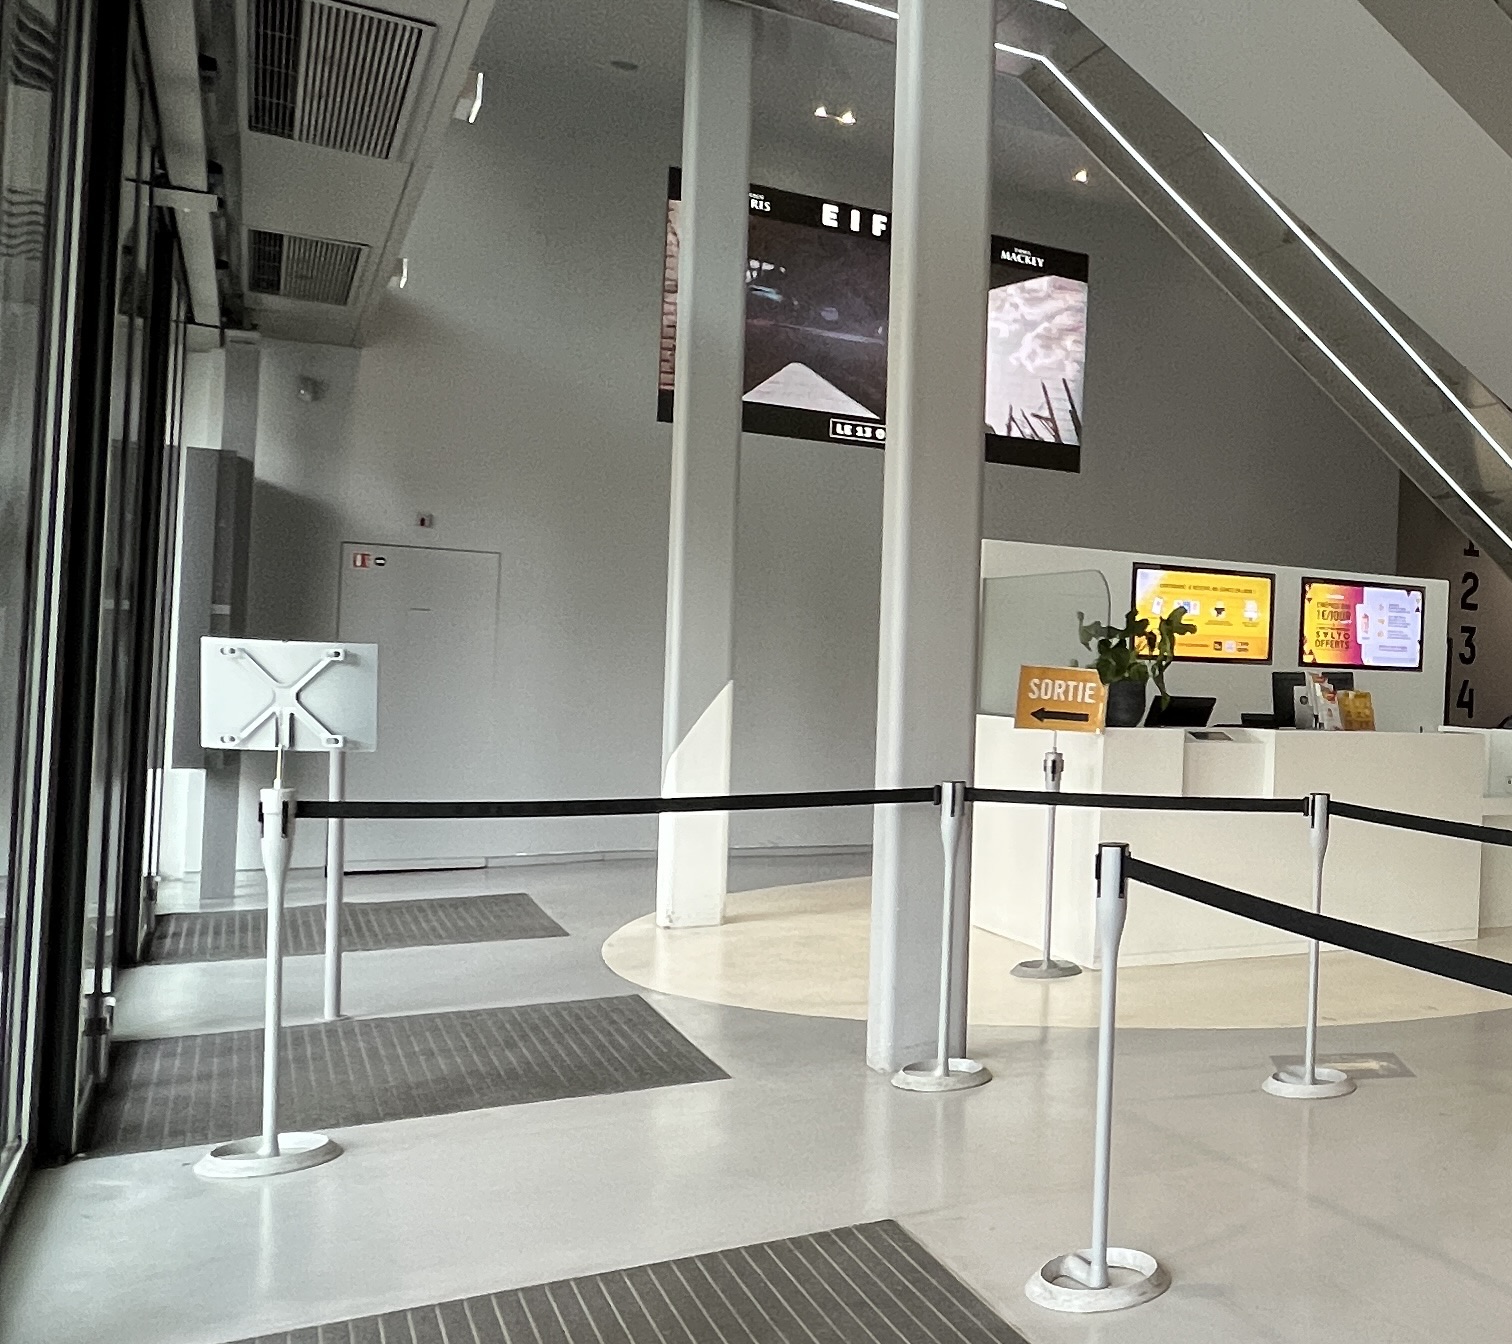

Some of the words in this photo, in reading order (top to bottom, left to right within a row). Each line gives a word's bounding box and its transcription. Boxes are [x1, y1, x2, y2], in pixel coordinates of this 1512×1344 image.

[821, 202, 887, 236] EIF
[1460, 571, 1479, 611] 2
[1458, 625, 1477, 665] 3
[1028, 678, 1097, 704] SORTIE
[1456, 679, 1475, 719] 4
